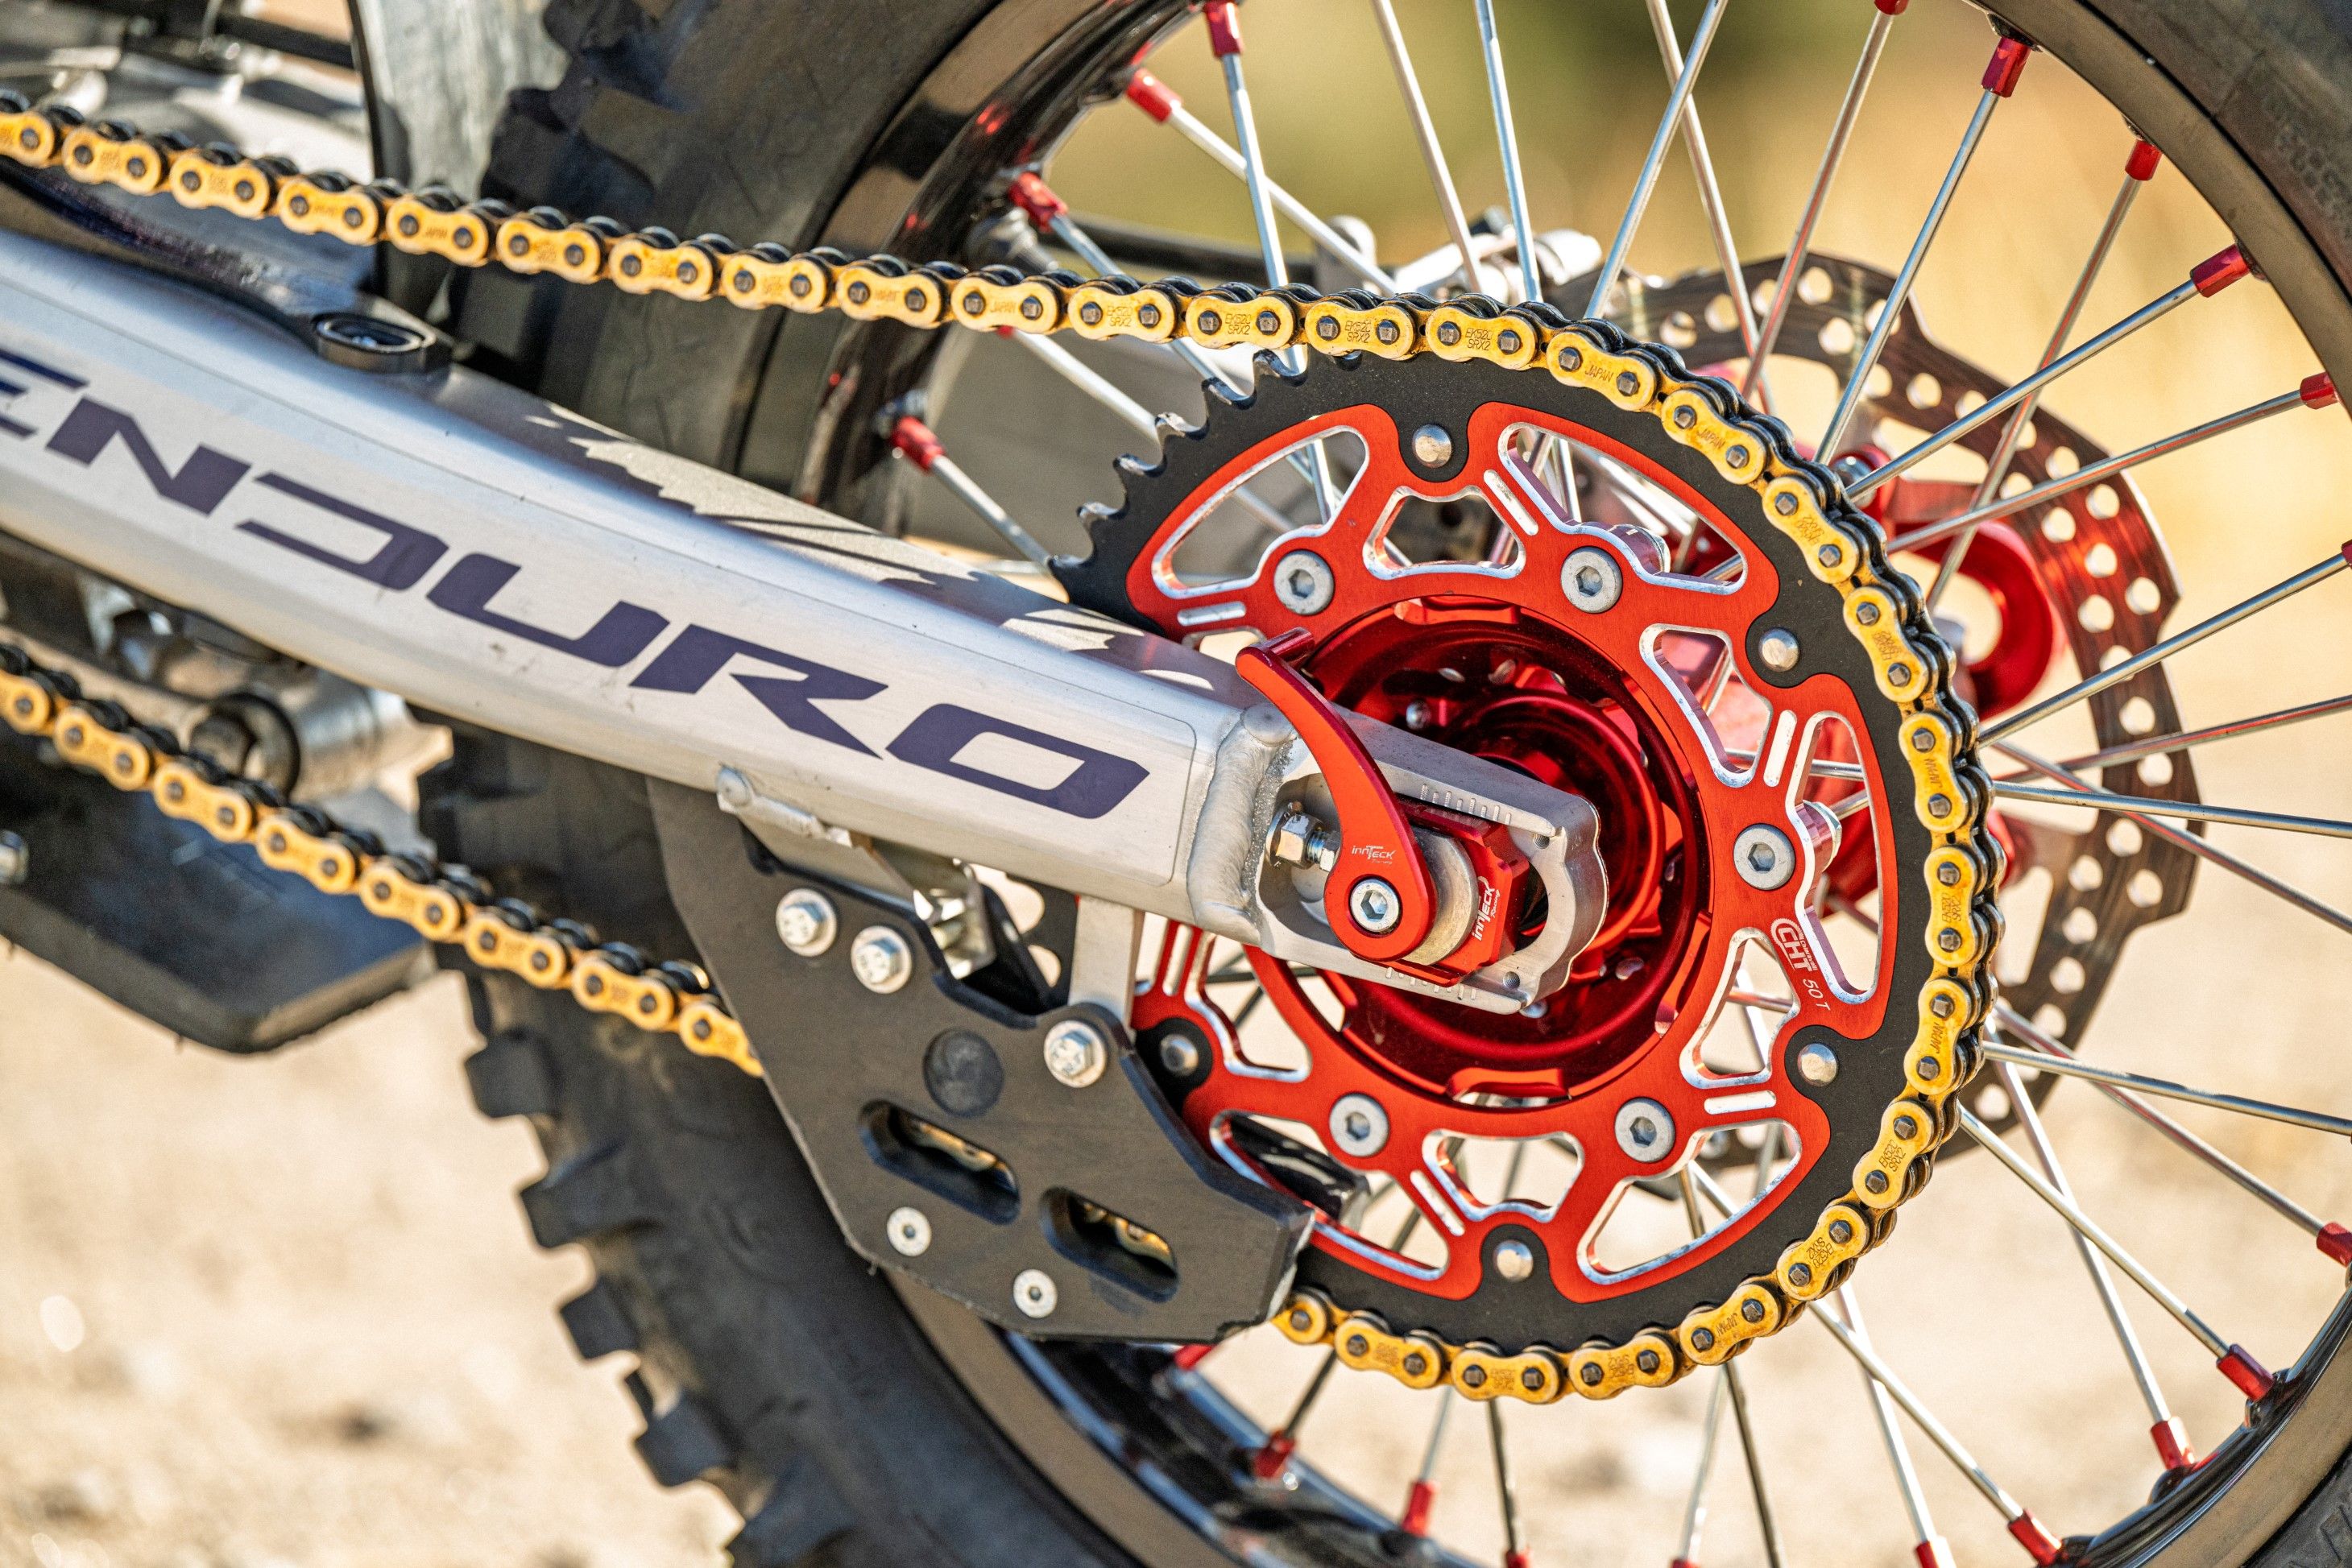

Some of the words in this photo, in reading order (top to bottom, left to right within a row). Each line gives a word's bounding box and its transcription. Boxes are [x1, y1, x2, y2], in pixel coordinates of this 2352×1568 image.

[990, 301, 1016, 313] JAPAN
[1109, 316, 1131, 327] SRX2
[1228, 325, 1250, 335] SRX2
[1347, 331, 1370, 343] SRX2
[1467, 339, 1489, 351] SRX2
[1584, 365, 1614, 383] JAPAN
[1696, 428, 1726, 449] JAPAN
[1924, 759, 1942, 788] JAPAN
[1950, 895, 1962, 922] SRX2
[1778, 927, 1812, 972] CHT
[1803, 978, 1824, 999] 50
[1930, 1022, 1944, 1054] JAPAN
[1888, 1147, 1907, 1172] SRX2
[1806, 1237, 1826, 1260] SRX2
[1812, 1243, 1834, 1268] EK520
[1716, 1313, 1738, 1336] JAPAN
